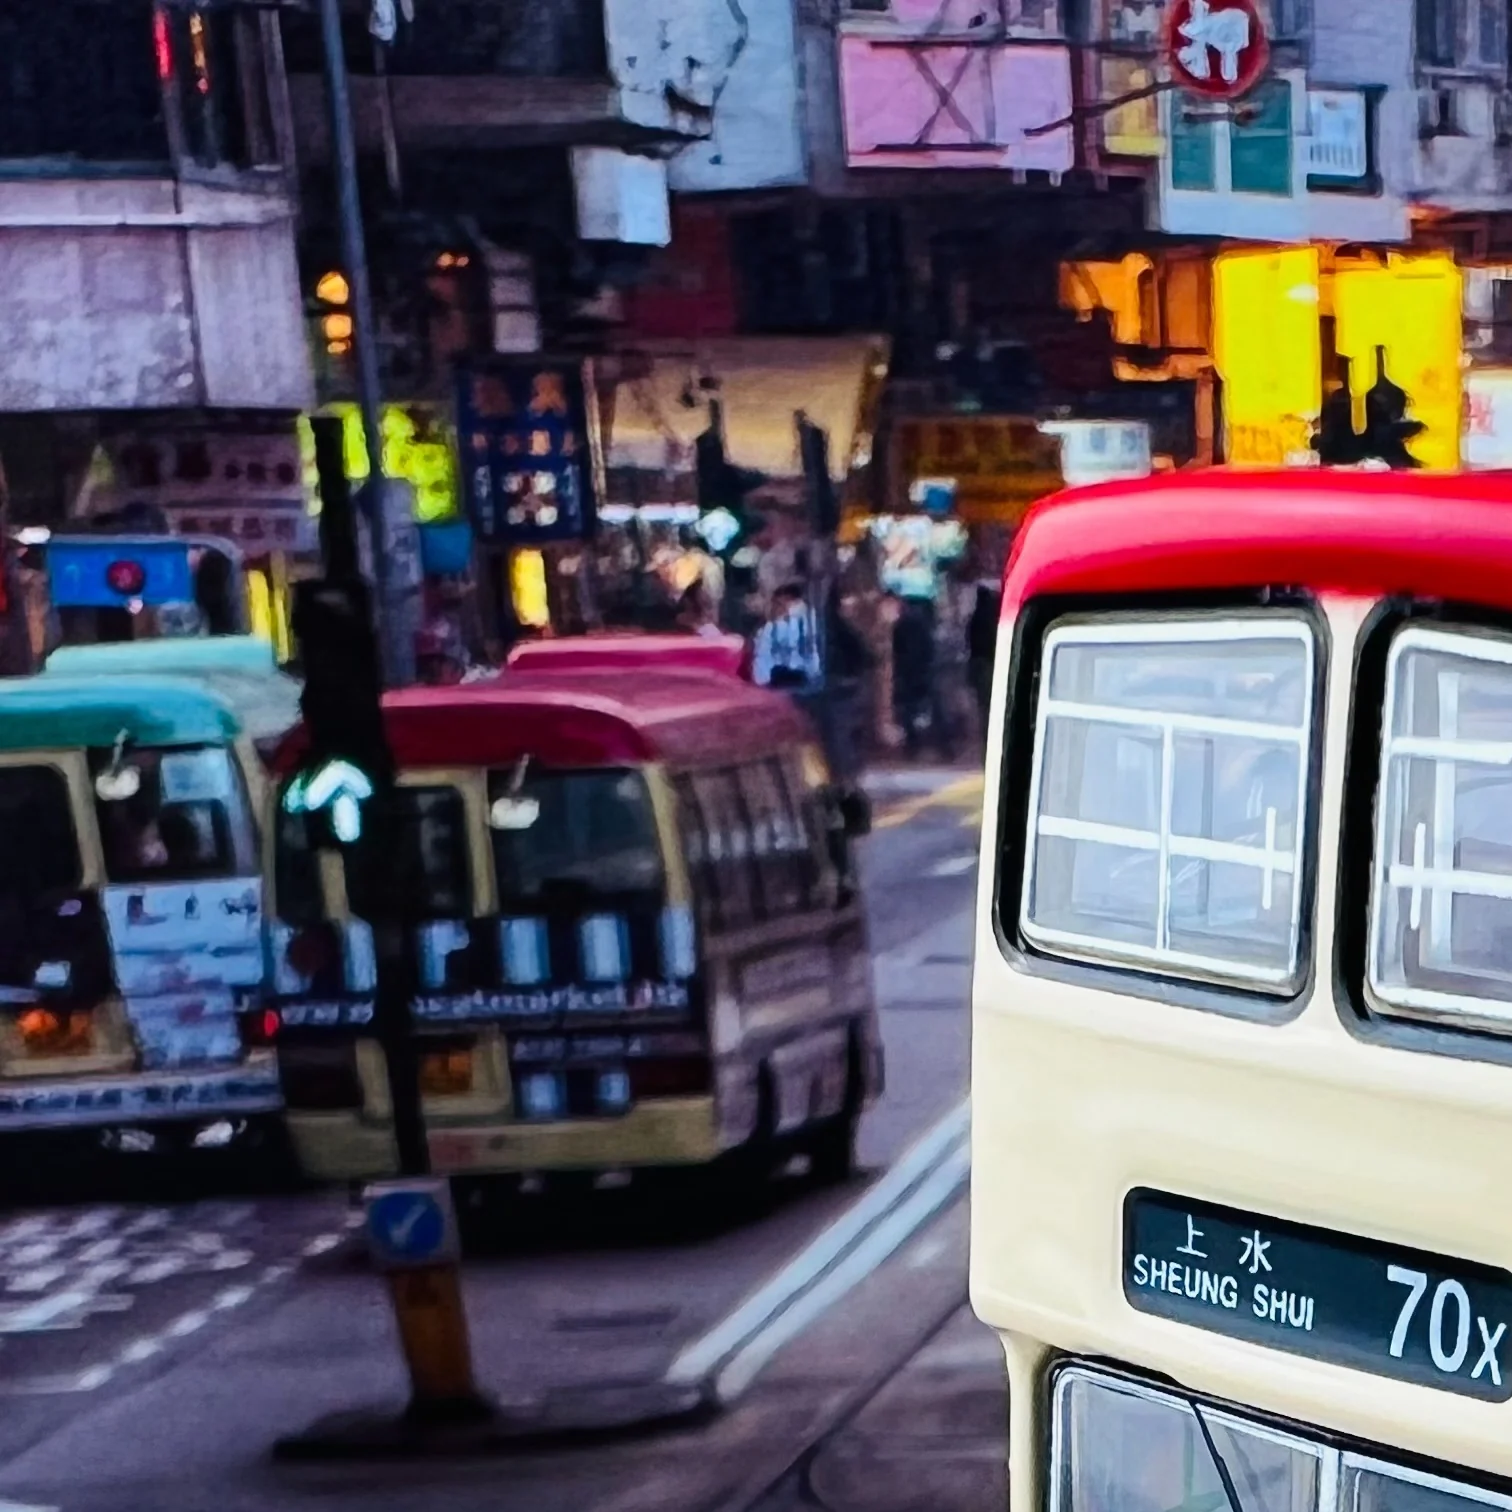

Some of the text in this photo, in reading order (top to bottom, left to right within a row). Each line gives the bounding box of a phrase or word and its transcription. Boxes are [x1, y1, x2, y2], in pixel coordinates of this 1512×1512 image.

[1176, 1213, 1273, 1274] 上水
[1133, 1253, 1315, 1332] SHEUNG SHUI
